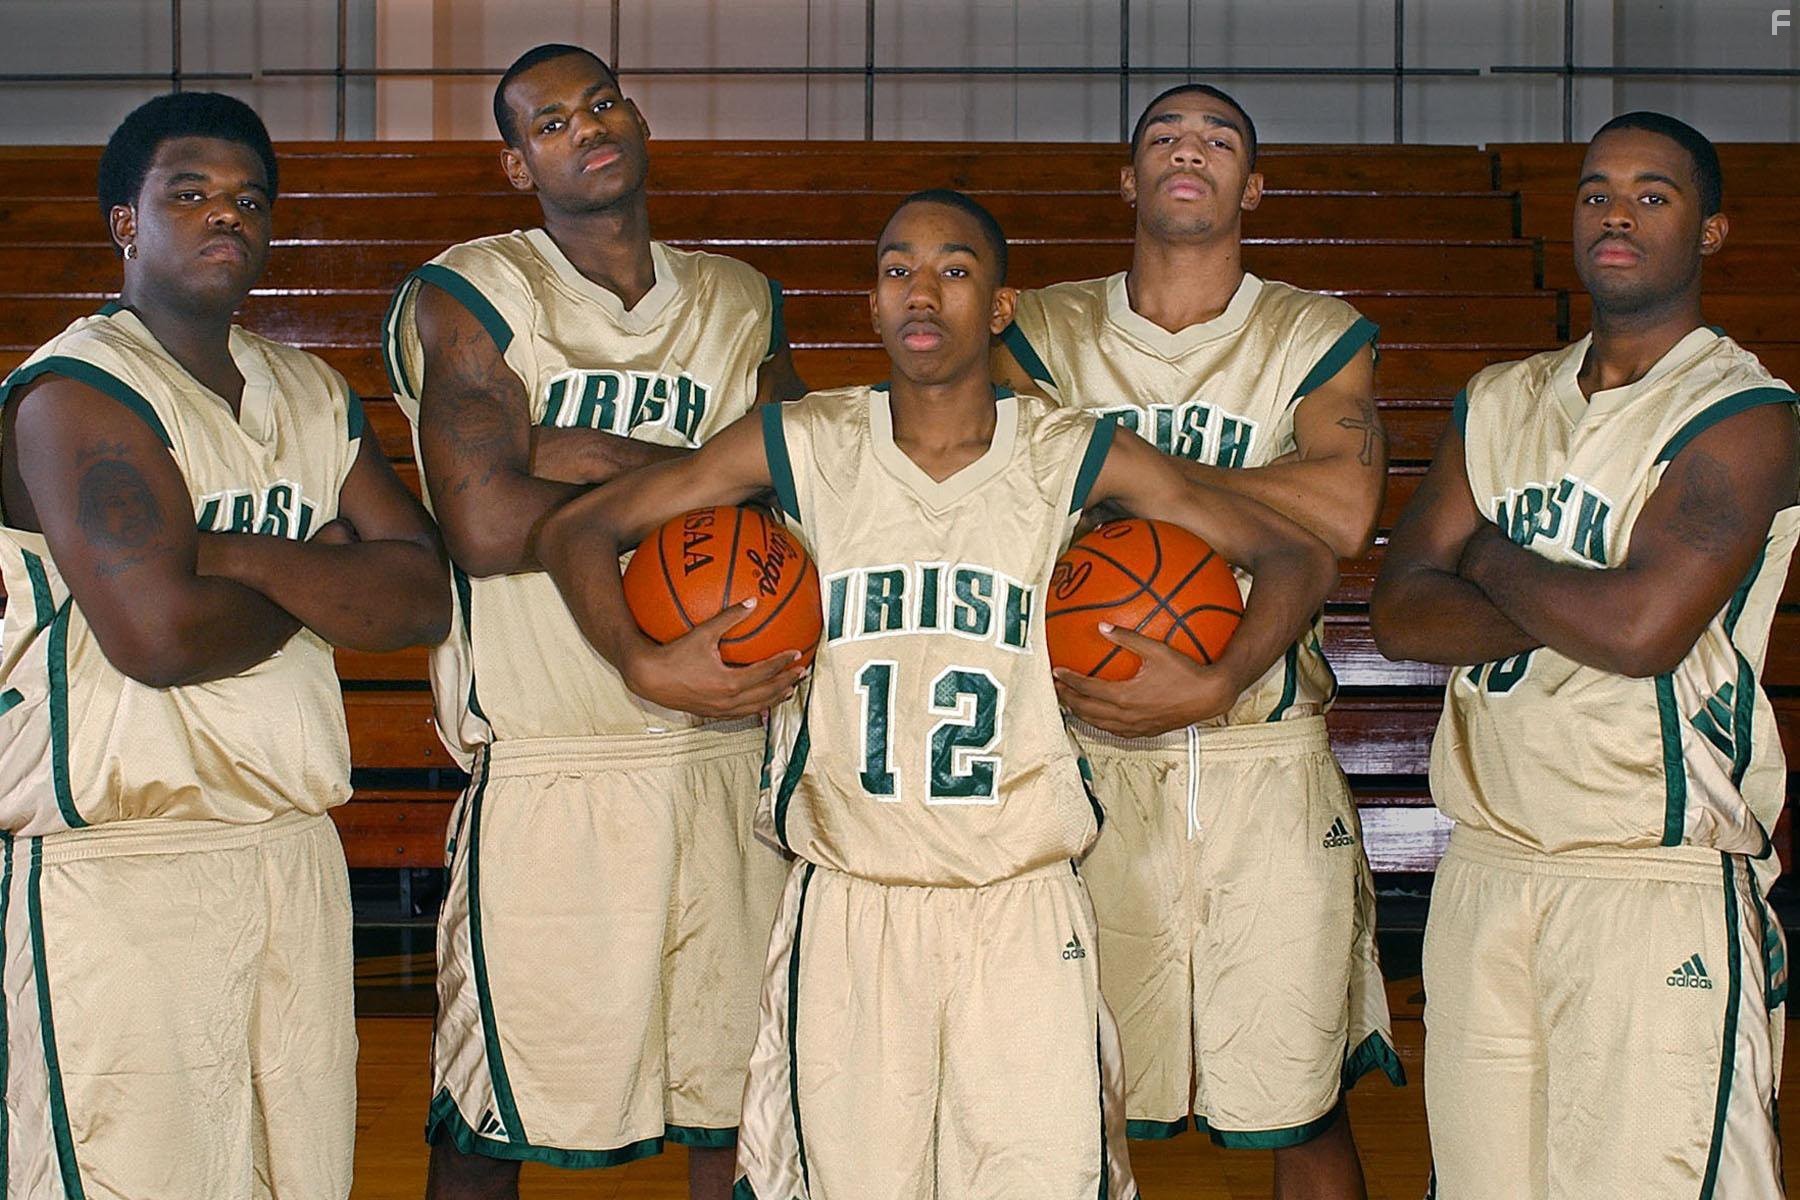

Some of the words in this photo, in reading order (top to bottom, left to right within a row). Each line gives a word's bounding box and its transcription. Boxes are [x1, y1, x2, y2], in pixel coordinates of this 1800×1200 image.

[823, 561, 1037, 655] IRISH
[854, 660, 1006, 805] 12
[1666, 974, 1713, 990] adidas
